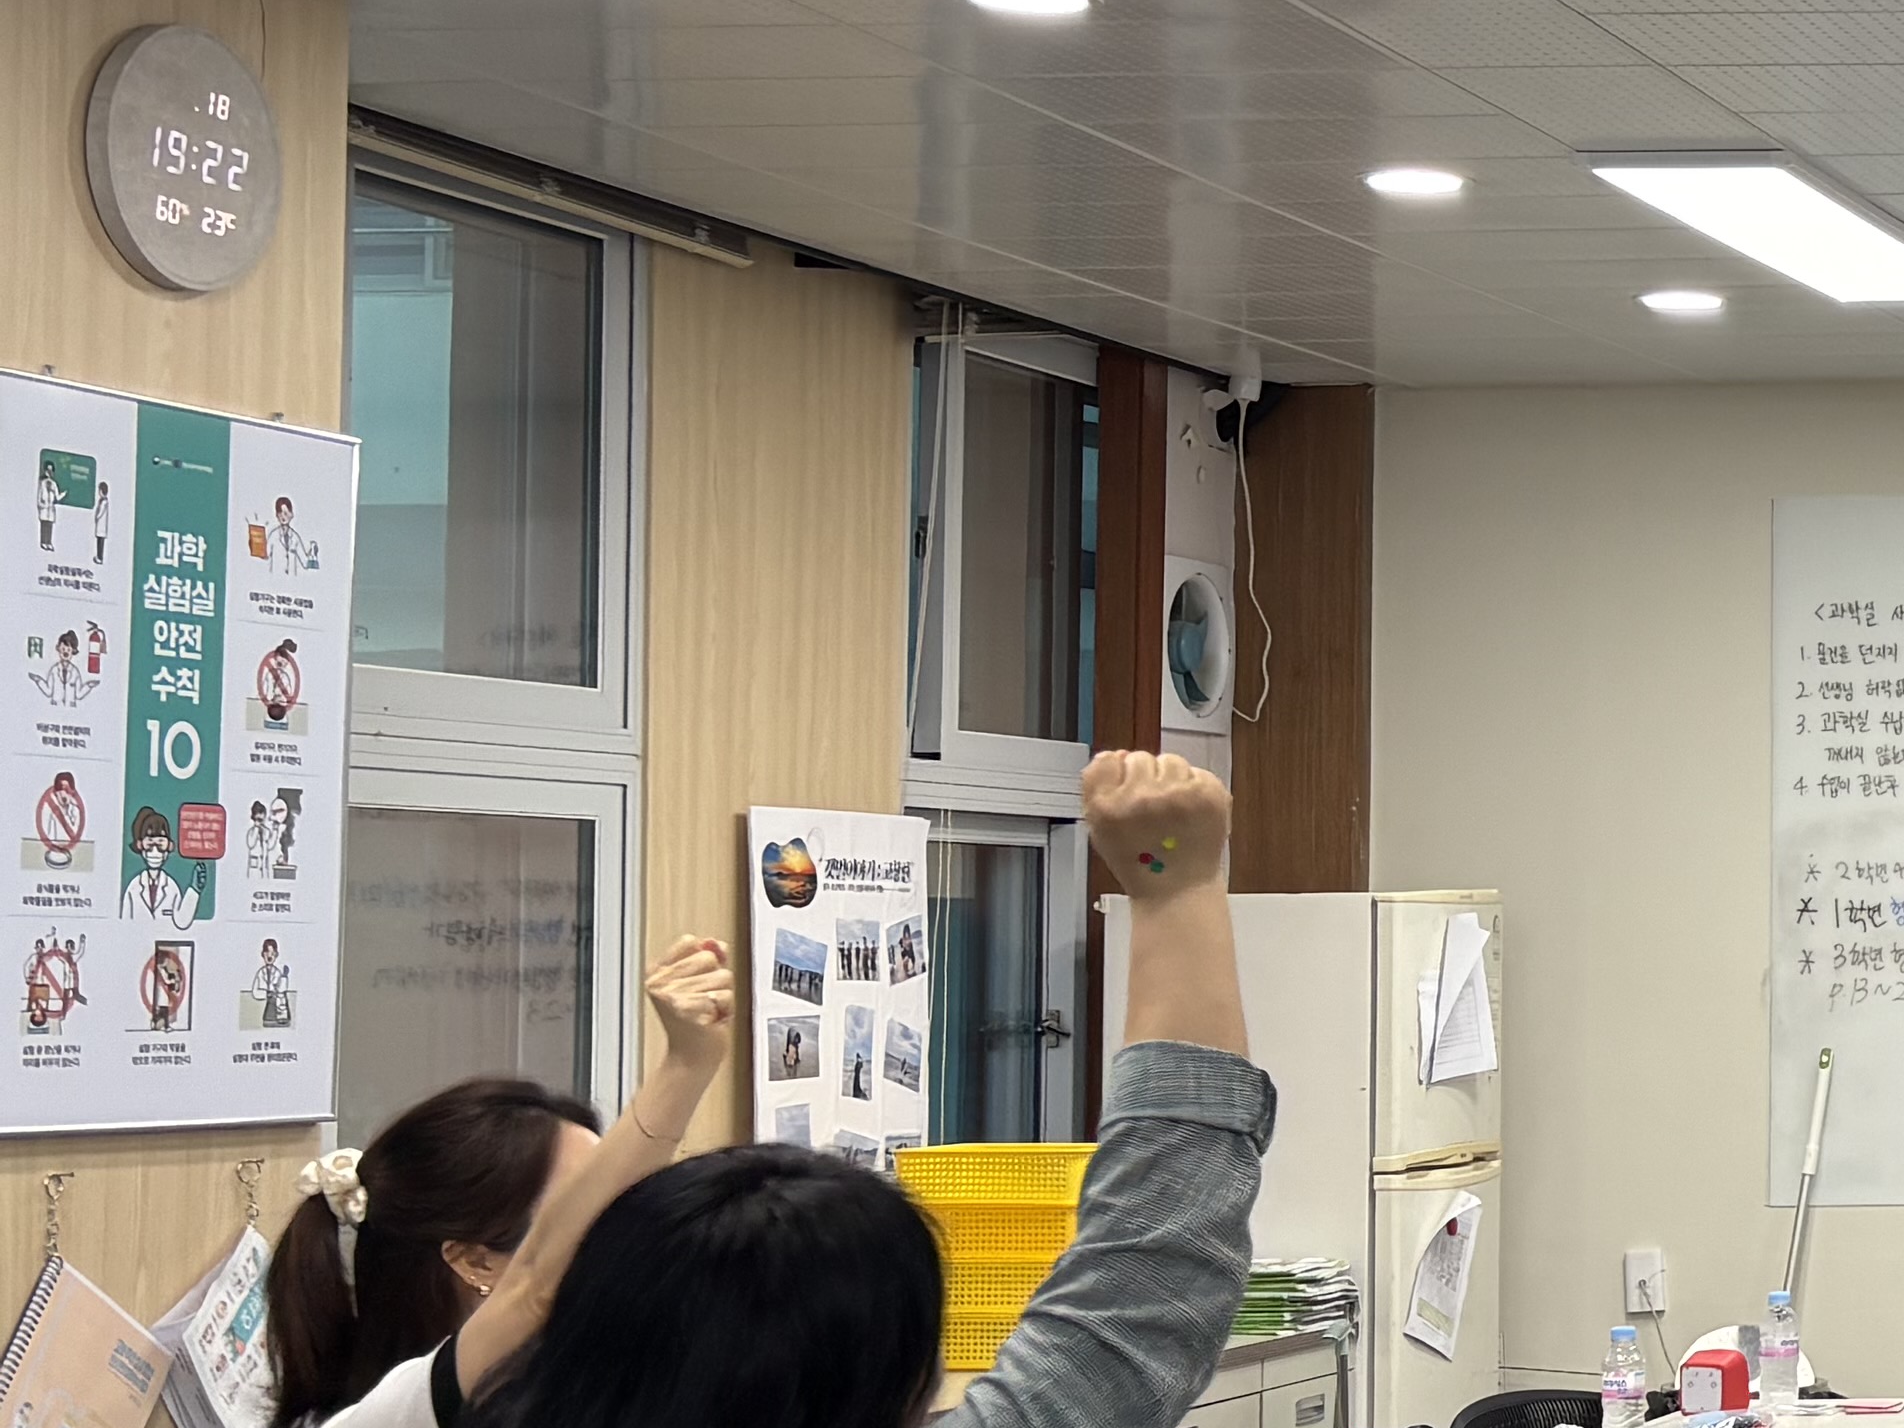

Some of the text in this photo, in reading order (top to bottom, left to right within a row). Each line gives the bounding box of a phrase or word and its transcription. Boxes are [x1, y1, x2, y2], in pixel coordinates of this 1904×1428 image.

[152, 126, 250, 192] 19:22
[155, 530, 207, 571] 과학
[143, 573, 215, 618] 실험실
[153, 619, 203, 661] 안전
[1817, 641, 1851, 665] 물건을
[1857, 641, 1898, 665] 던지지
[152, 665, 200, 705] 수칙
[1818, 680, 1854, 702] 선생님
[1820, 710, 1870, 734] 과학실
[146, 719, 202, 780] 10
[1816, 774, 1850, 798] 수업이
[1834, 897, 1888, 933] 1학년
[1833, 942, 1885, 972] 3학년
